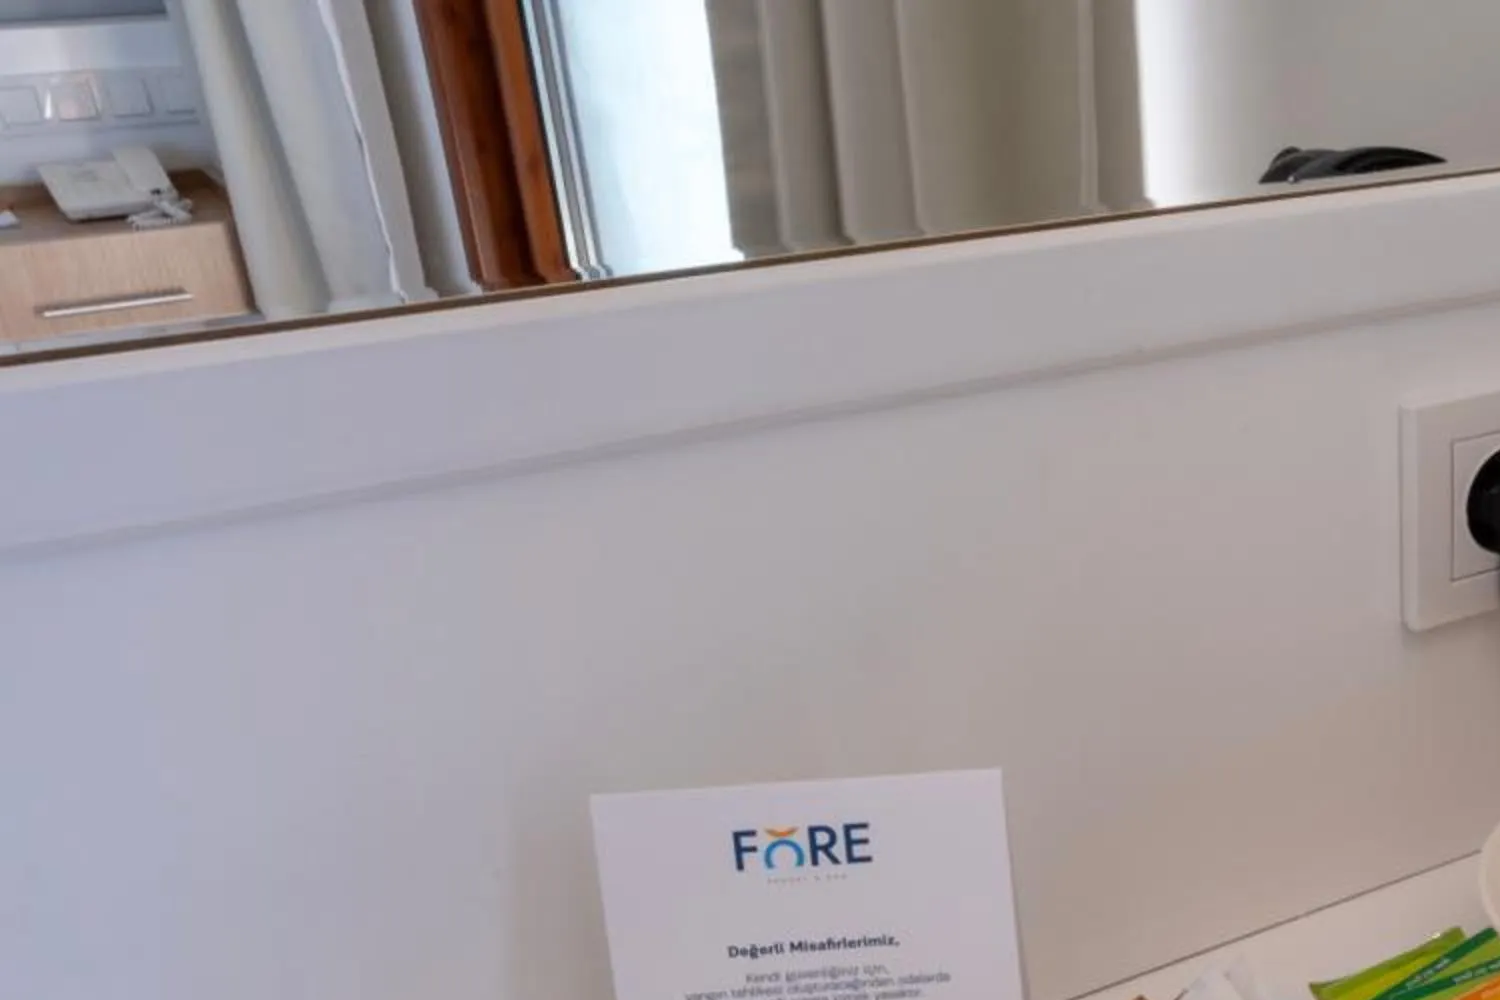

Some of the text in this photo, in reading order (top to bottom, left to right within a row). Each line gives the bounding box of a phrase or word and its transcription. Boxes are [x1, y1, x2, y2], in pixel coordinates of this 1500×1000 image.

[732, 822, 873, 872] FORE
[727, 934, 901, 960] Değerli Misafirlerimiz,
